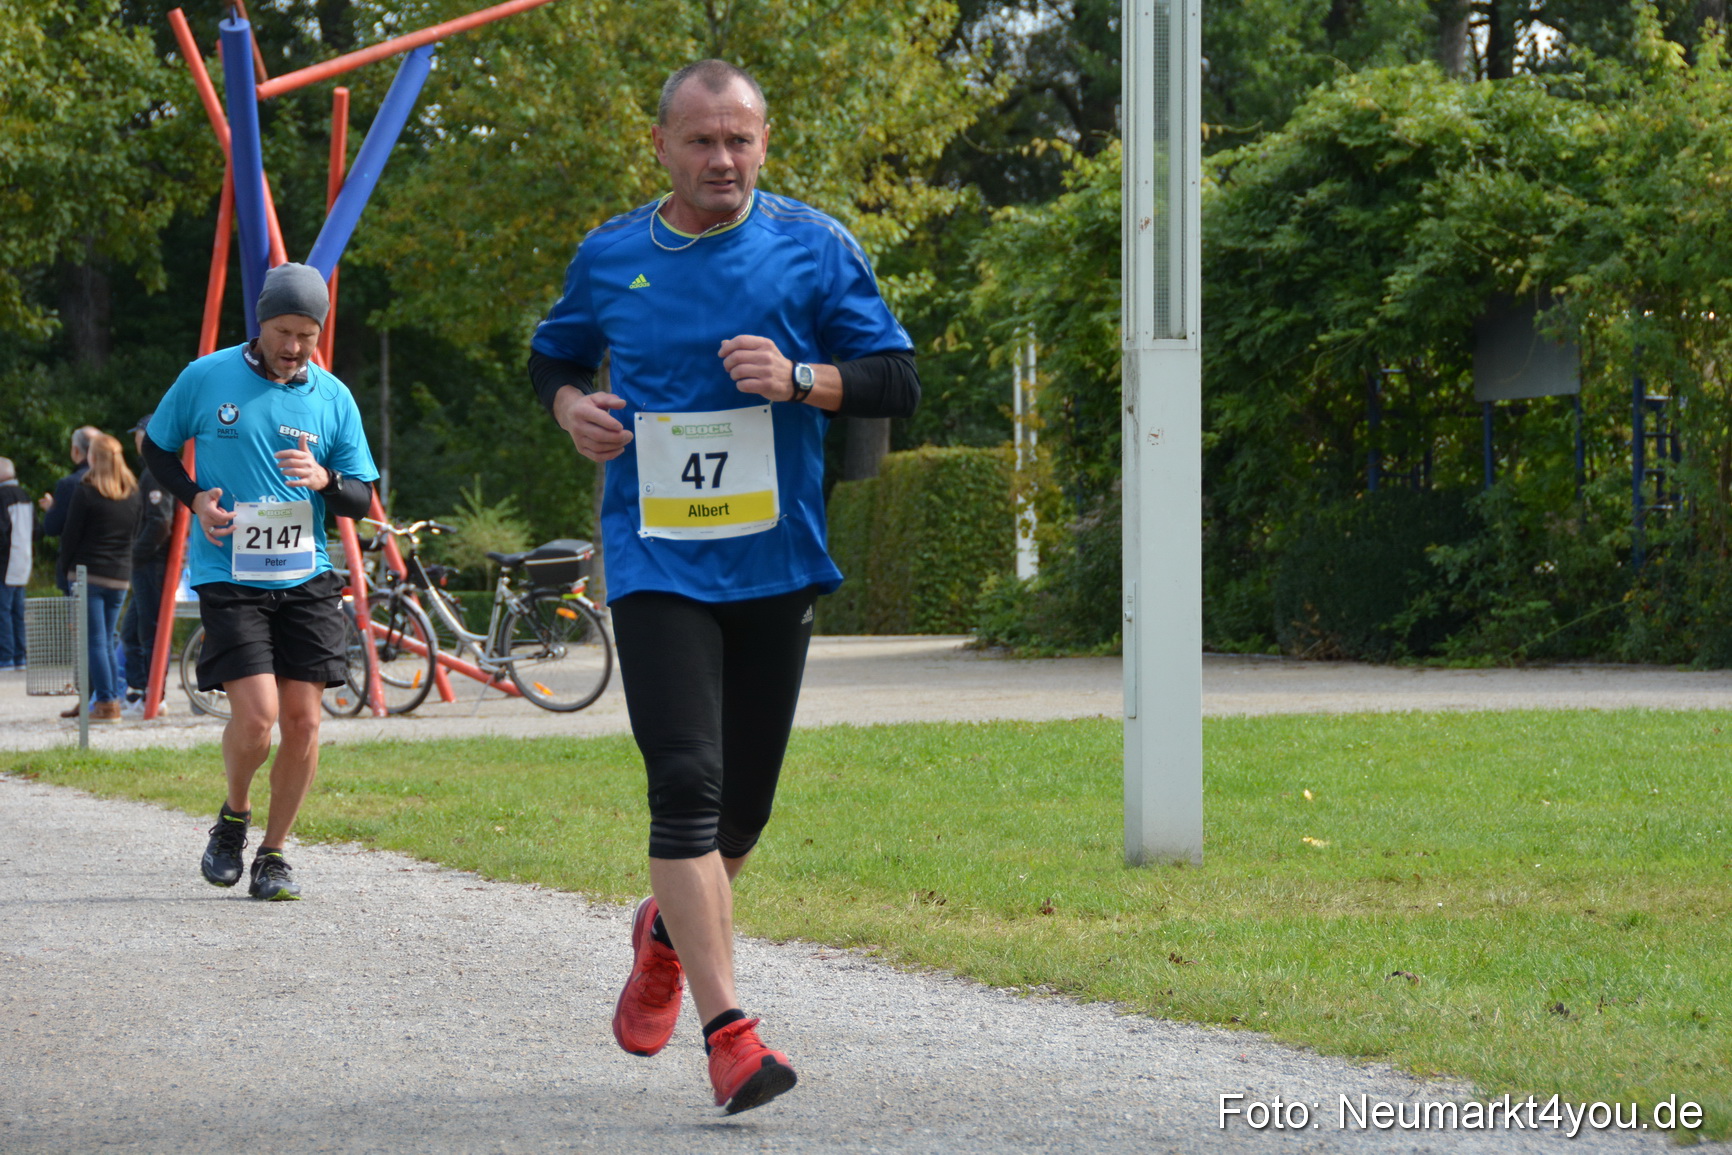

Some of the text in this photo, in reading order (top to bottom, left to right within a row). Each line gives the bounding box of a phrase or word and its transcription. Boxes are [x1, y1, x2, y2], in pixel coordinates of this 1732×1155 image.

[685, 423, 732, 435] BOCK
[681, 451, 729, 489] 47
[688, 503, 730, 517] Albert
[246, 525, 302, 549] 2147
[265, 558, 287, 566] Peter
